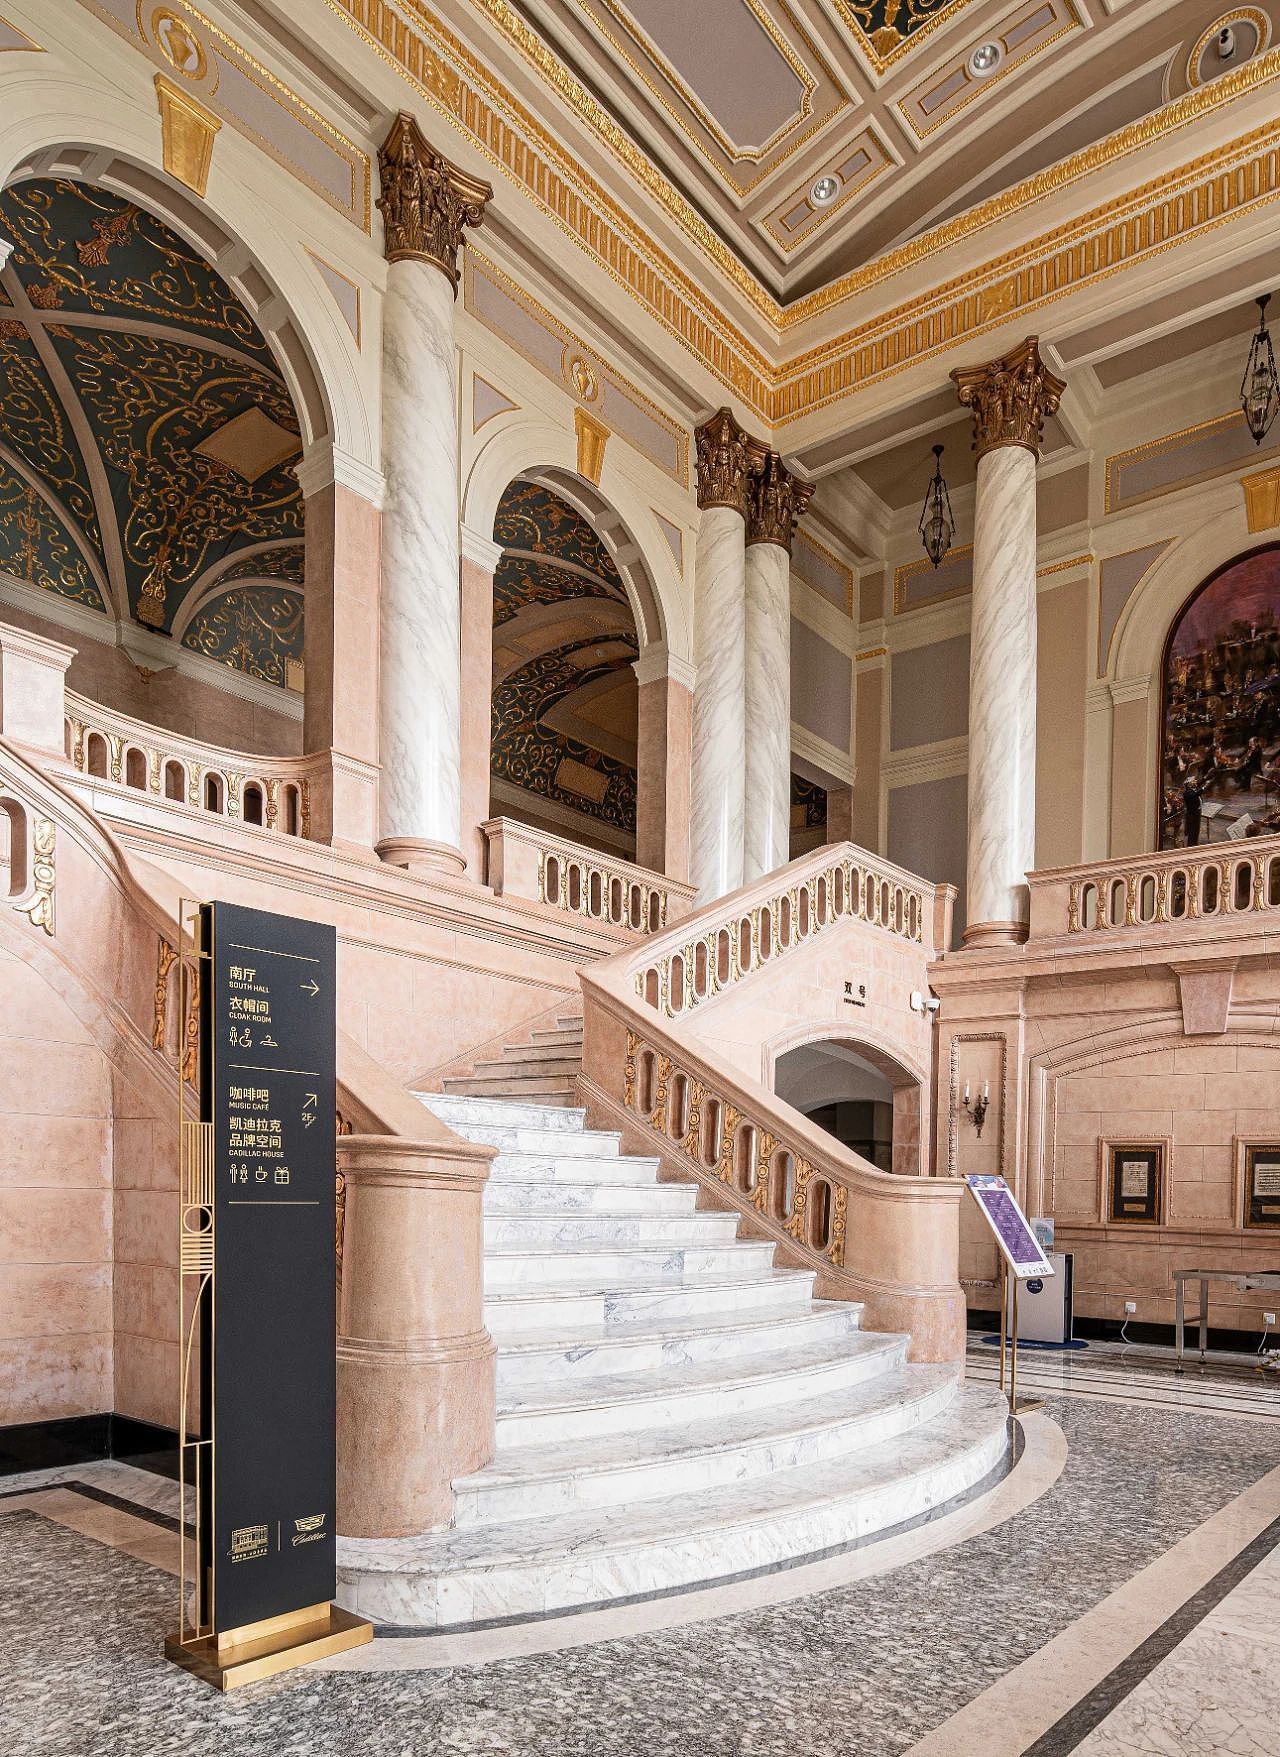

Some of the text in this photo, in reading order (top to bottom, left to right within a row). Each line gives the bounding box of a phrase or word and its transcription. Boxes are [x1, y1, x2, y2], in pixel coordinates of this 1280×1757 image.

[229, 965, 257, 982] 南厅
[228, 981, 270, 994] SOUTH HALL
[229, 996, 269, 1015] 衣帽间
[228, 1011, 272, 1024] CLOAK ROOM
[229, 1086, 269, 1103] 咖啡吧
[228, 1101, 251, 1110] MUSIC
[301, 1112, 312, 1121] 2F
[229, 1116, 282, 1133] 凯迪拉克
[229, 1133, 282, 1149] 品牌空间
[228, 1149, 285, 1159] CADILLAC HOUSE
